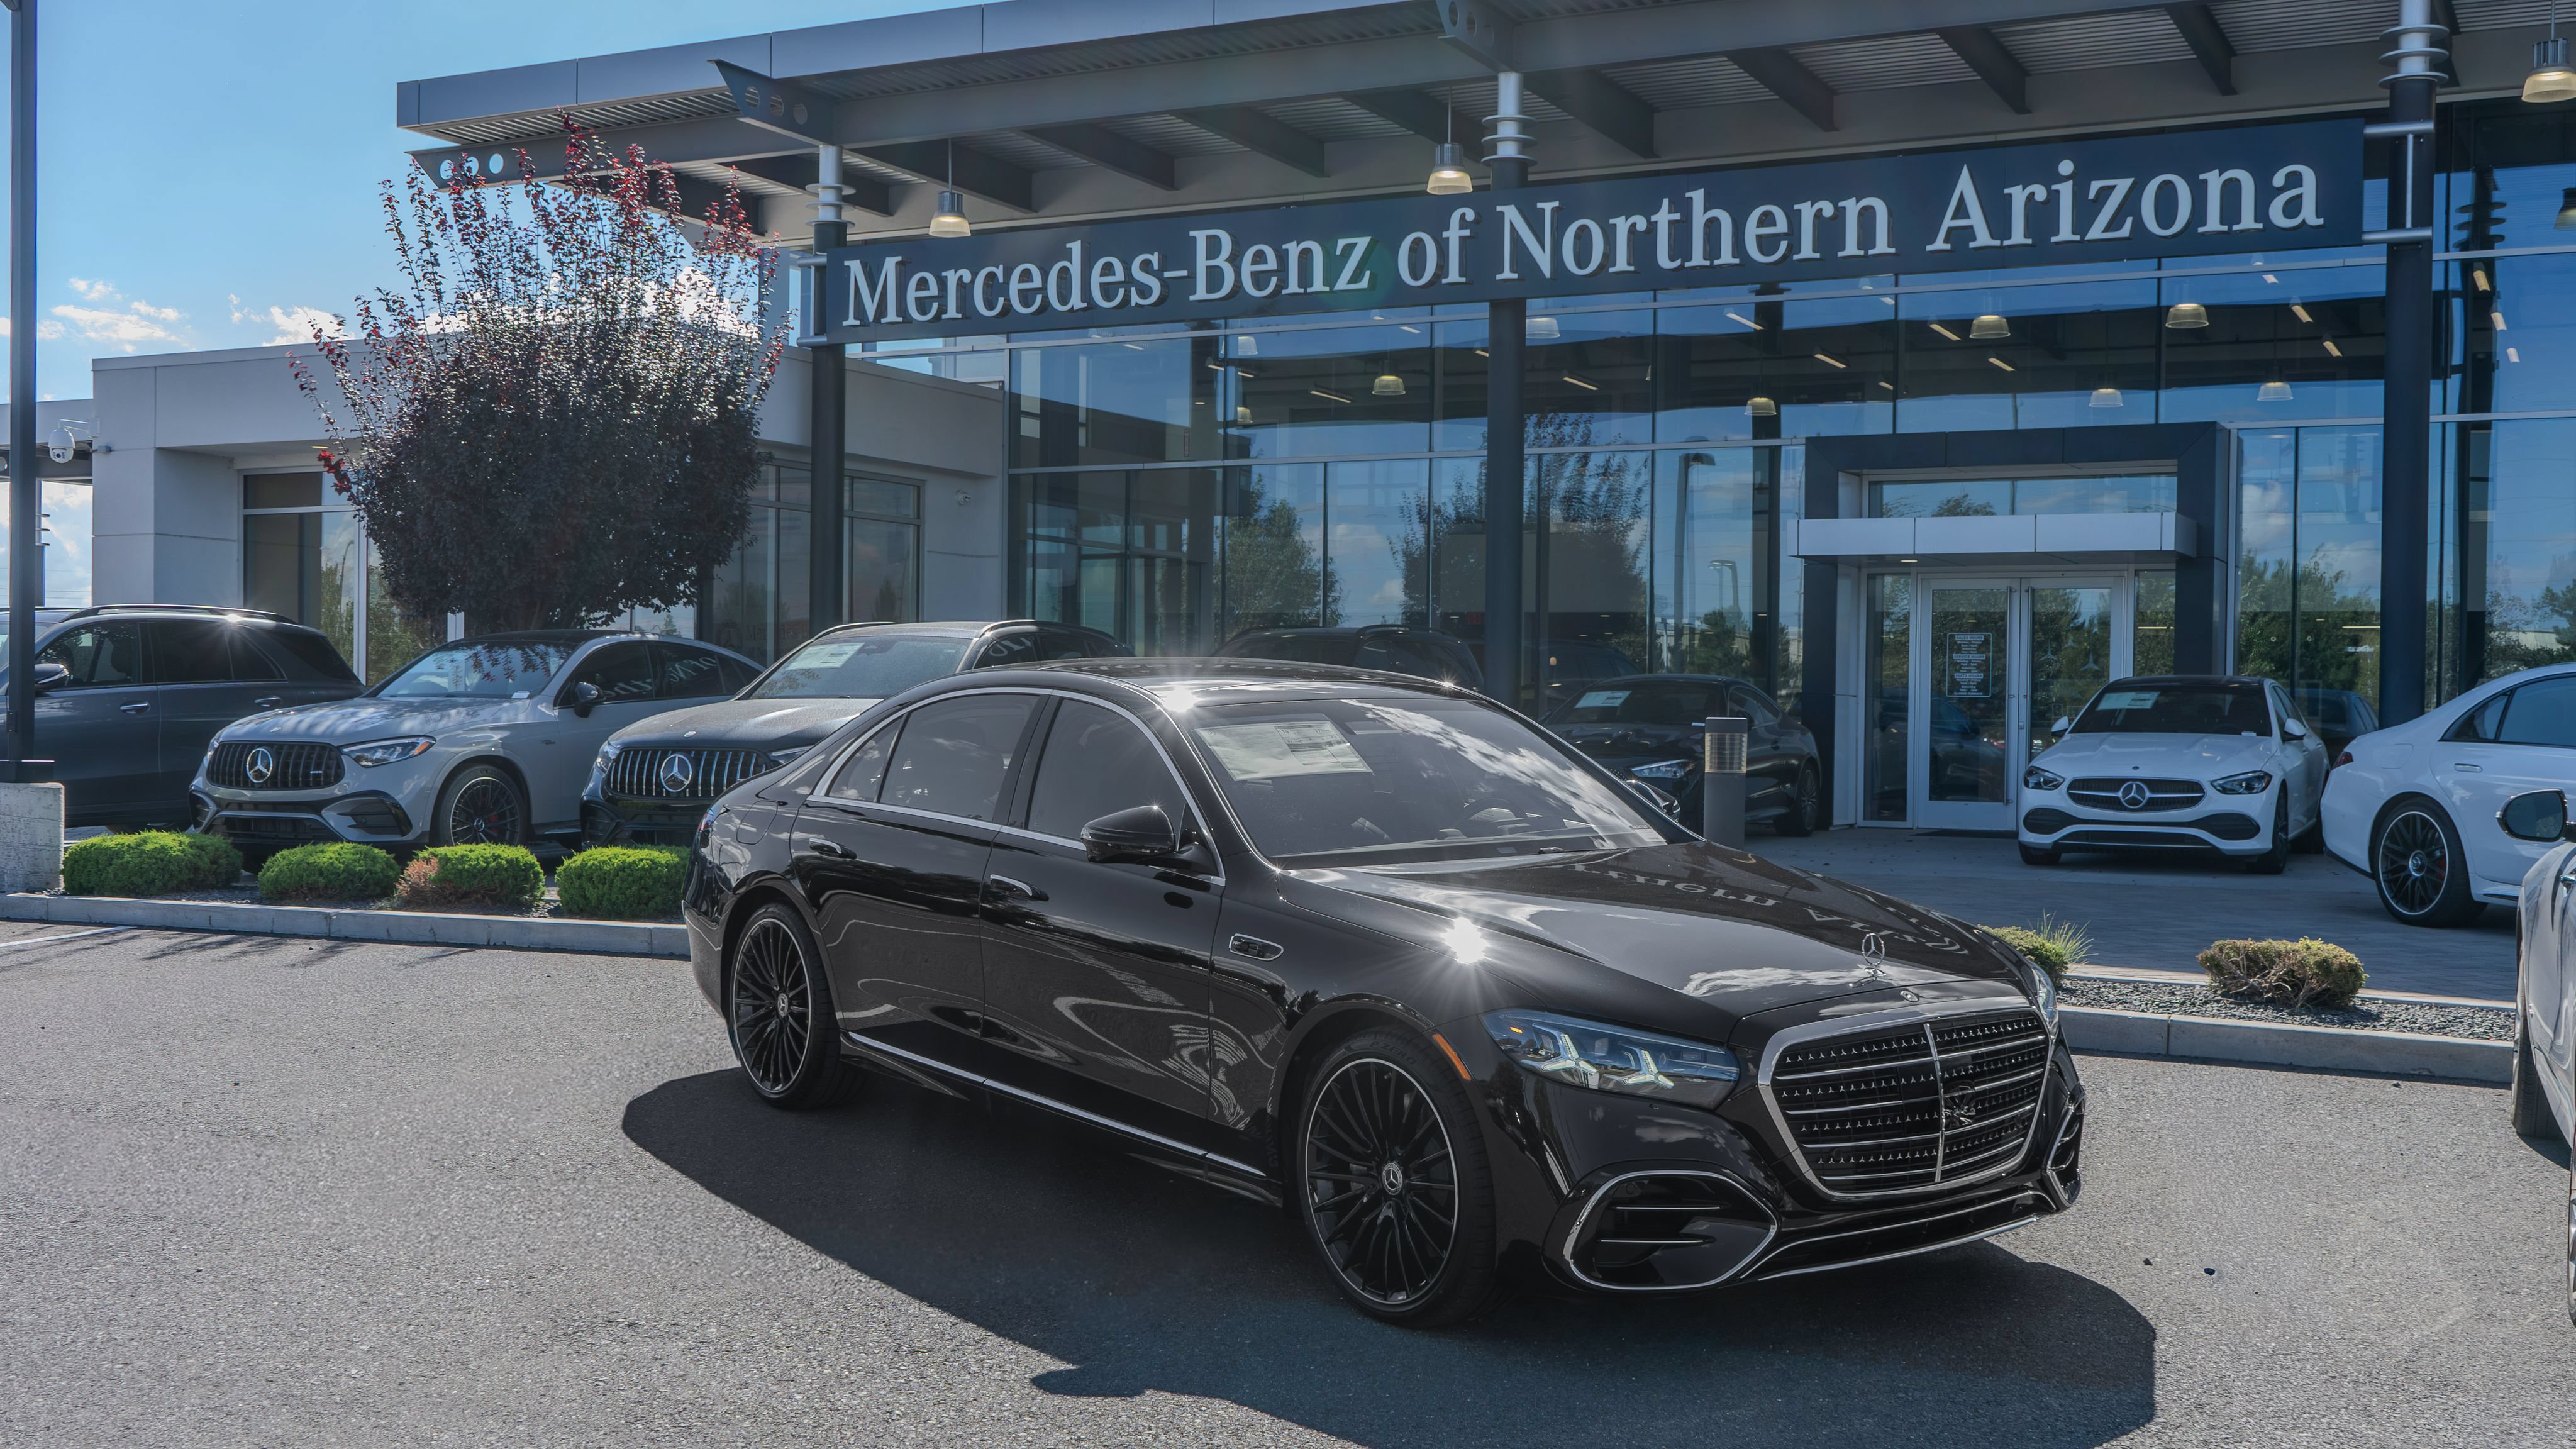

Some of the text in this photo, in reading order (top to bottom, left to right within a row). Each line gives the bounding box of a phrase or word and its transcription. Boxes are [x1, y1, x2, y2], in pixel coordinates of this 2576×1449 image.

[842, 160, 2324, 326] Mercedes-Benz of Northern Arizona
[1380, 1043, 1417, 1065] ZERO
